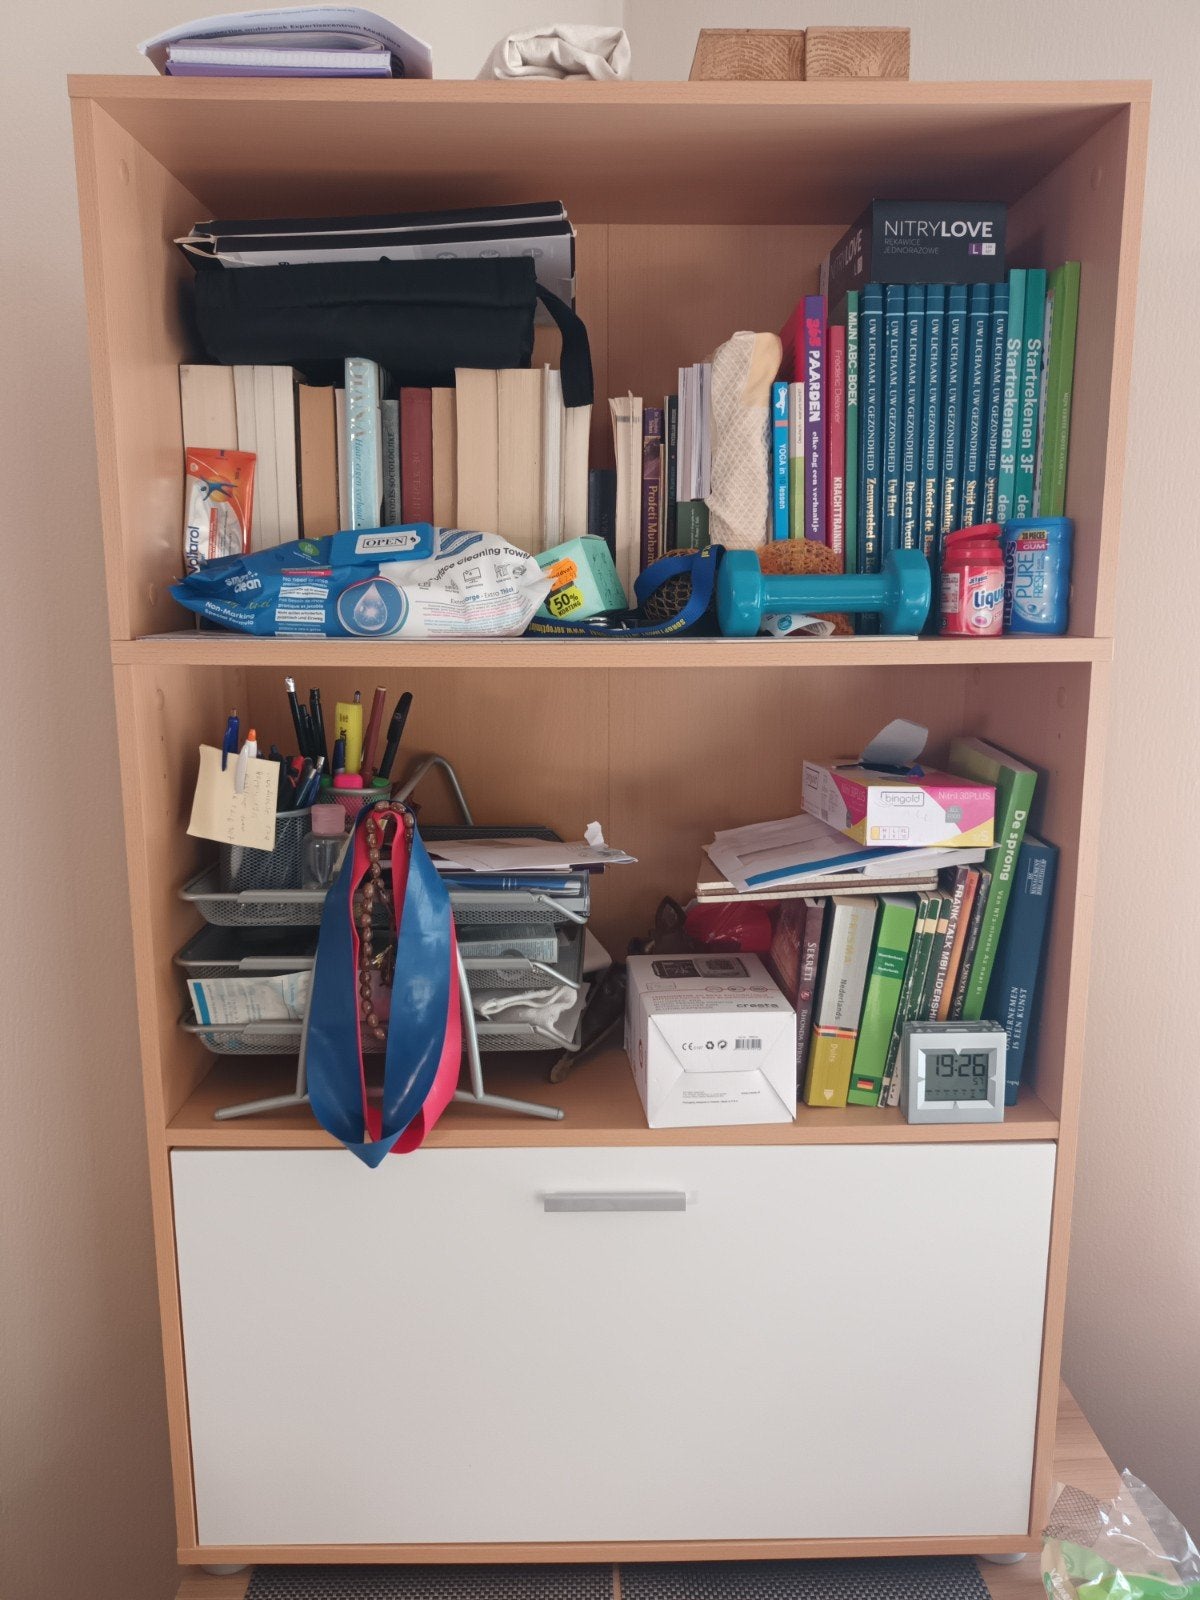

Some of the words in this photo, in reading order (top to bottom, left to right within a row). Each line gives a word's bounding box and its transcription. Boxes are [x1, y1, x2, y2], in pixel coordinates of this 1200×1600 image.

[884, 220, 994, 238] NITRYLOVE
[971, 243, 979, 255] L
[807, 318, 822, 347] 365
[847, 311, 858, 340] MIJN
[870, 318, 878, 335] UW
[891, 320, 900, 337] UW
[910, 319, 919, 336] UW
[931, 318, 941, 335] UW
[952, 318, 961, 335] UW
[976, 320, 986, 336] UW
[996, 318, 1006, 334] UW
[808, 349, 821, 423] PAARDEN
[847, 343, 858, 407] ABC-BOEK
[868, 388, 876, 405] UW
[890, 389, 898, 406] UW
[908, 388, 916, 405] UW
[929, 387, 937, 405] UW
[949, 387, 957, 405] UW
[973, 389, 982, 406] UW
[993, 387, 1002, 405] UW
[1001, 338, 1021, 449] Startrekenen
[1021, 338, 1042, 449] Startrekenen
[867, 405, 876, 471] GEZONDHEID
[888, 407, 897, 473] GEZONDHEID
[906, 406, 916, 472] GEZONDHEID
[927, 405, 937, 471] GEZONDHEID
[946, 405, 957, 471] GEZONDHEID
[969, 407, 980, 472] GEZONDHEID
[989, 405, 1001, 471] GEZONDHEID
[779, 443, 787, 465] YOGA
[810, 452, 819, 468] dag
[1001, 453, 1015, 474] 3F
[1021, 453, 1034, 474] 3F
[353, 462, 363, 486] eigen
[779, 467, 787, 475] in
[648, 485, 658, 520] Profeti
[779, 486, 787, 509] lessen
[906, 480, 915, 505] Dieet
[925, 477, 936, 518] Infecties
[964, 479, 977, 504] Strijd
[985, 476, 996, 515] Spieren
[811, 487, 820, 533] verhaaltje
[832, 476, 844, 554] KRACHTTRAINING
[888, 494, 898, 517] Hart
[905, 506, 914, 518] en
[943, 476, 955, 534] Ademhaling
[1018, 494, 1030, 519] dee
[925, 520, 934, 532] de
[965, 506, 975, 529] tege
[186, 526, 200, 576] Voltarol
[365, 537, 404, 547] OPEN
[865, 541, 874, 553] en
[233, 578, 262, 594] clean
[1003, 540, 1017, 626] mentos
[1016, 552, 1034, 599] PURE
[1032, 571, 1045, 599] FRESH
[204, 601, 255, 620] Non-Marking
[553, 593, 579, 611] 50%
[558, 602, 582, 617] KORTING
[884, 792, 921, 806] bingold
[938, 792, 958, 800] Nitril
[1011, 809, 1027, 829] De
[998, 831, 1022, 881] sprong
[951, 884, 965, 920] FRANK
[997, 889, 1005, 905] Van
[844, 913, 859, 965] PRISMA
[944, 923, 956, 949] TALK
[804, 941, 817, 981] SEKRETI
[939, 951, 950, 971] MBI
[978, 965, 988, 984] naar
[835, 978, 848, 1020] Nederlands
[930, 972, 946, 1022] LIDERSHI
[1015, 987, 1028, 1019] KUNST
[798, 1008, 808, 1040] RHONDA
[1013, 1021, 1022, 1038] EEN
[828, 1042, 839, 1063] Duits
[1012, 1041, 1019, 1050] IS
[936, 1054, 986, 1077] 19:26
